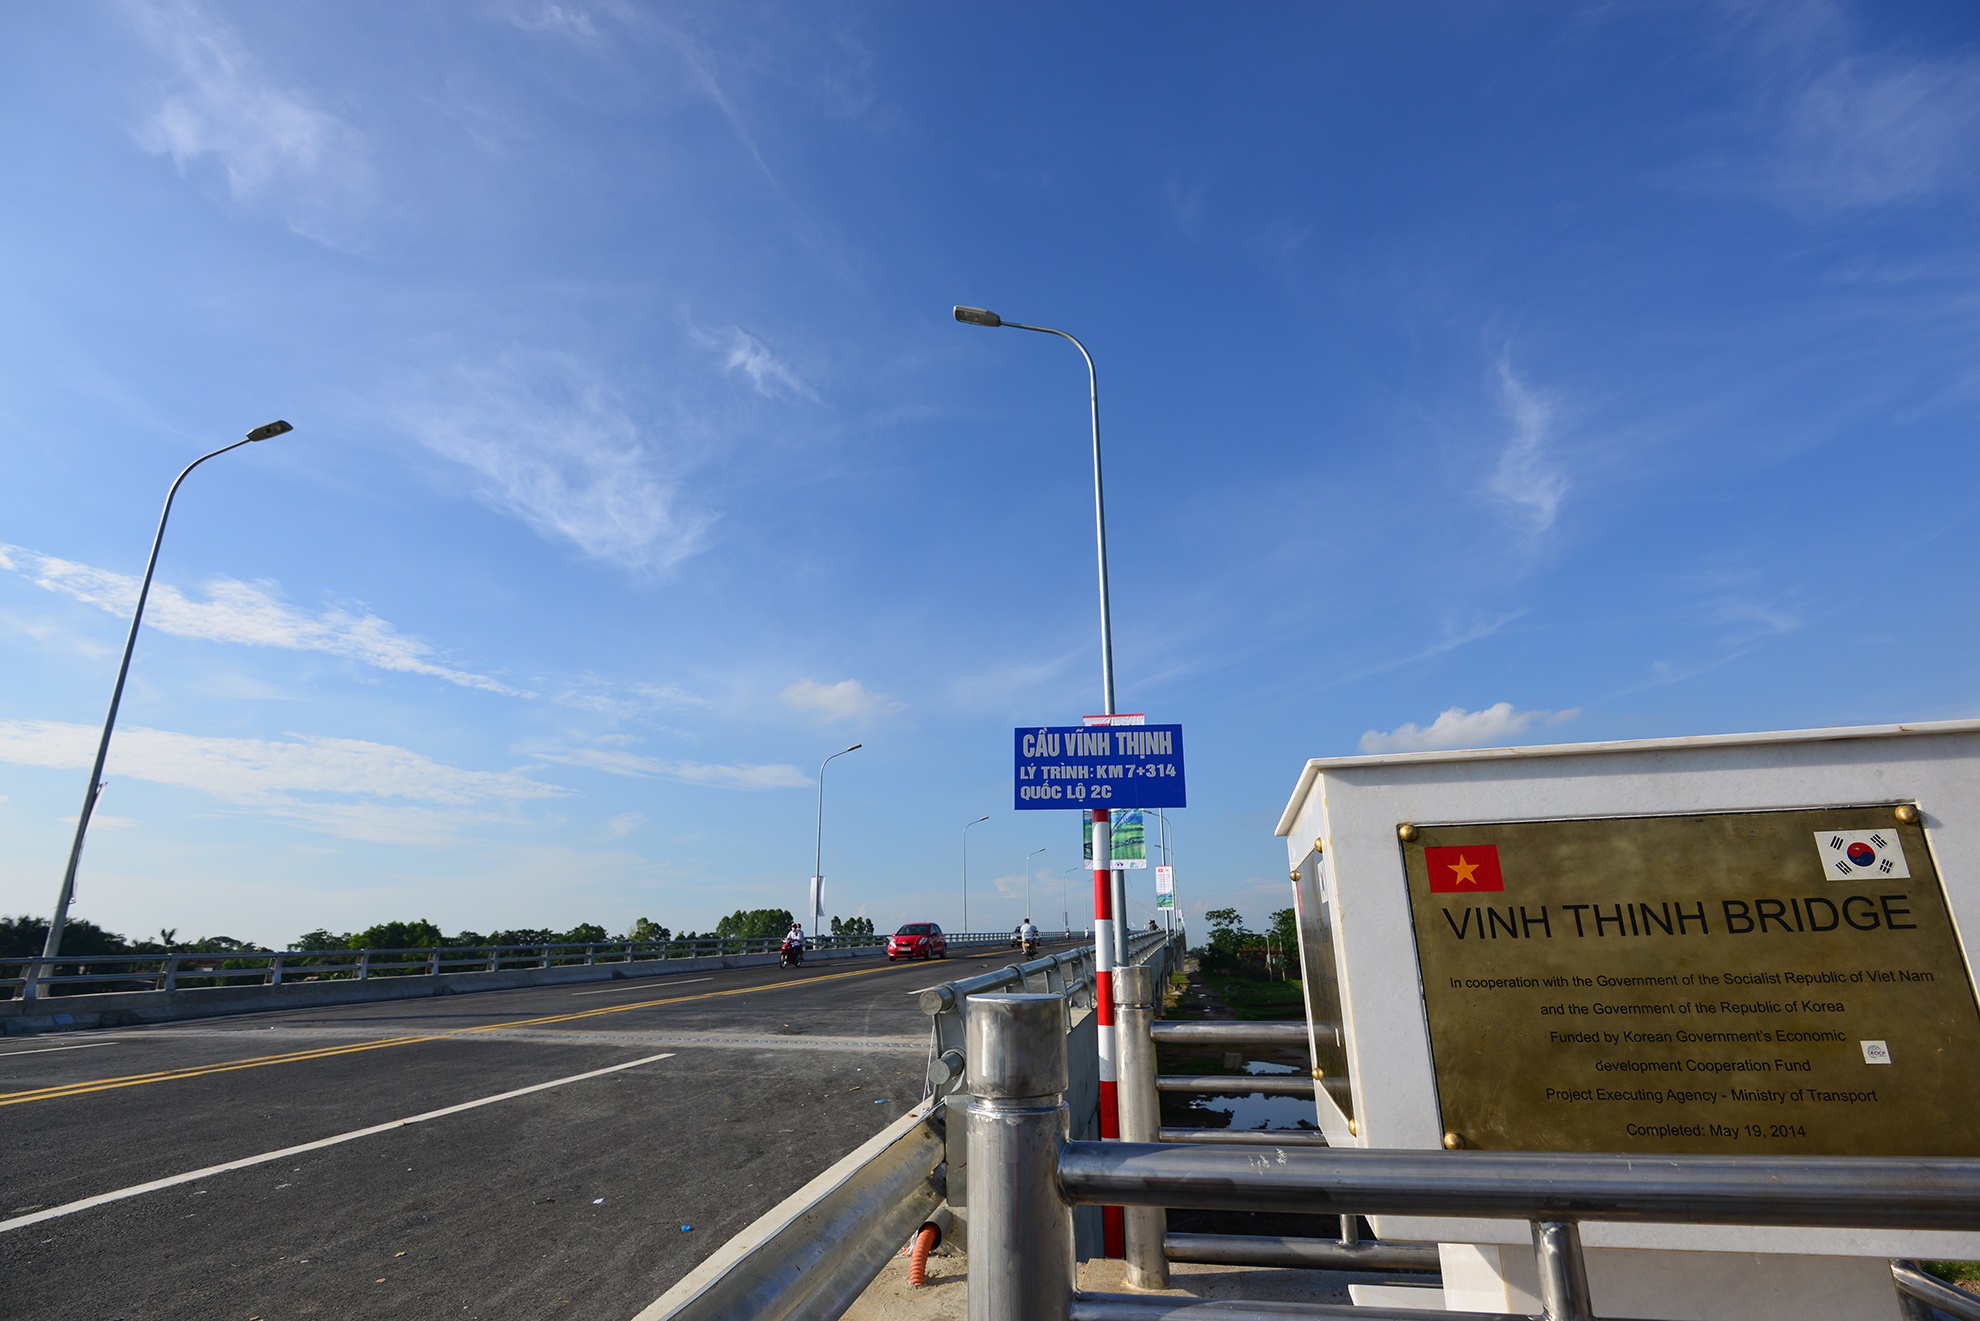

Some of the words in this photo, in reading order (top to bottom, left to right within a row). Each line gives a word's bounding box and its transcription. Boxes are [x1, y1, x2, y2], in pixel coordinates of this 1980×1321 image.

[1022, 728, 1060, 757] CẦU
[1064, 728, 1110, 756] VĨNH
[1115, 731, 1173, 759] THỊNH
[1020, 763, 1037, 779] LÝ
[1041, 762, 1093, 779] TRÌNH:
[1020, 780, 1062, 800] QUỐC
[1066, 782, 1086, 802] LỘ
[1090, 785, 1112, 798] 2C
[1442, 906, 1551, 939] VINH
[1562, 901, 1708, 937] THINH
[1722, 895, 1917, 934] BRIDGE
[1450, 977, 1462, 988] In
[1466, 977, 1539, 990] cooperation
[1543, 976, 1569, 987] with
[1572, 976, 1592, 987] the
[1597, 975, 1678, 986] Government
[1682, 974, 1694, 985] of
[1698, 974, 1719, 985] the
[1724, 973, 1782, 984] Socialist
[1784, 972, 1846, 986] Republic
[1850, 971, 1863, 982] of
[1866, 971, 1896, 982] Viet
[1899, 970, 1934, 982] Nam
[1541, 1004, 1564, 1015] and
[1568, 1004, 1589, 1014] the
[1593, 1003, 1675, 1014] Government
[1679, 1002, 1690, 1014] of
[1695, 1002, 1716, 1013] the
[1720, 1001, 1781, 1015] Republic
[1785, 1001, 1797, 1012] of
[1802, 1001, 1845, 1012] Korea
[1550, 1031, 1600, 1043] Funded
[1604, 1032, 1619, 1045] by
[1623, 1031, 1672, 1042] Korean
[1776, 1030, 1846, 1041] Economic
[1596, 1060, 1683, 1074] development
[1686, 1060, 1771, 1074] Cooperation
[1775, 1059, 1811, 1071] Fund
[1546, 1088, 1593, 1103] Project
[1596, 1089, 1663, 1103] Executing
[1667, 1089, 1717, 1104] Agency
[1731, 1089, 1785, 1104] Ministry
[1790, 1089, 1803, 1101] of
[1807, 1089, 1878, 1104] Transport
[1627, 1124, 1706, 1138] Completed:
[1709, 1124, 1739, 1139] May
[1745, 1125, 1766, 1139] 19,
[1770, 1125, 1806, 1137] 2014
